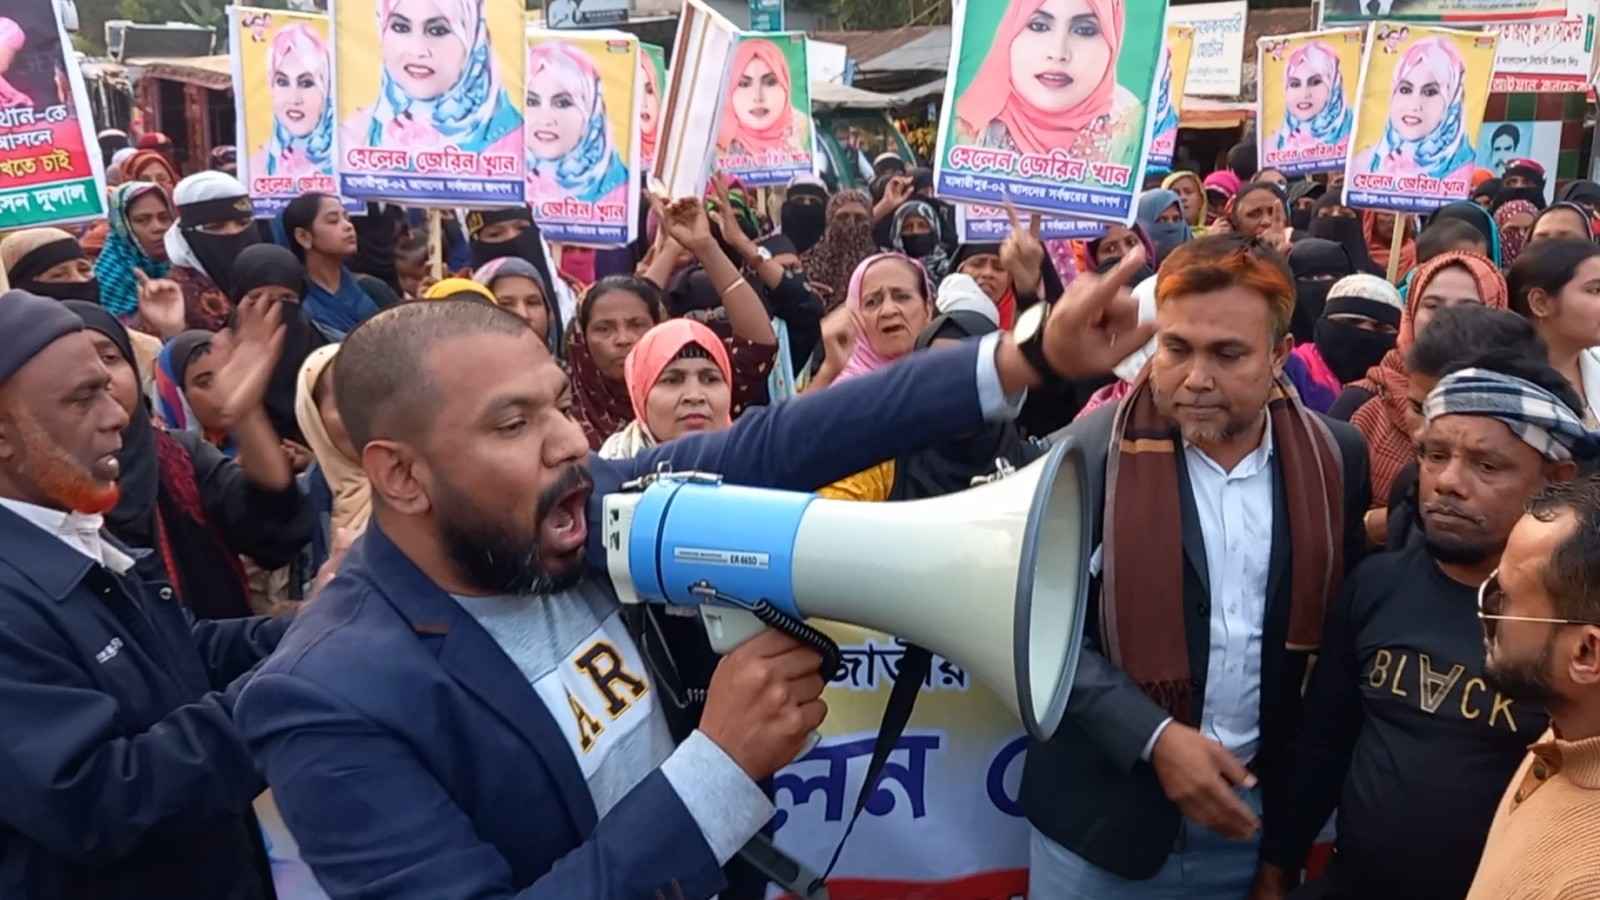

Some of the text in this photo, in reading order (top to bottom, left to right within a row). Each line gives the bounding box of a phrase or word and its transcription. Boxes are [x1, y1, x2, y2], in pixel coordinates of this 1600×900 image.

[41, 149, 75, 173] চাই
[347, 145, 517, 177] হেলেন জেরিন খান
[950, 147, 1132, 187] হেলেন জেরিন খান
[31, 185, 89, 212] দুলাল
[945, 174, 1007, 196] মাদারীপুর-০২
[1009, 184, 1046, 199] আসনের
[1049, 187, 1088, 203] সর্বস্তরের
[1091, 194, 1122, 208] জনগণ
[1353, 173, 1466, 197] হেলেন জেরিন খান
[542, 196, 624, 222] জেরিন খান
[1369, 650, 1517, 732] BLACK
